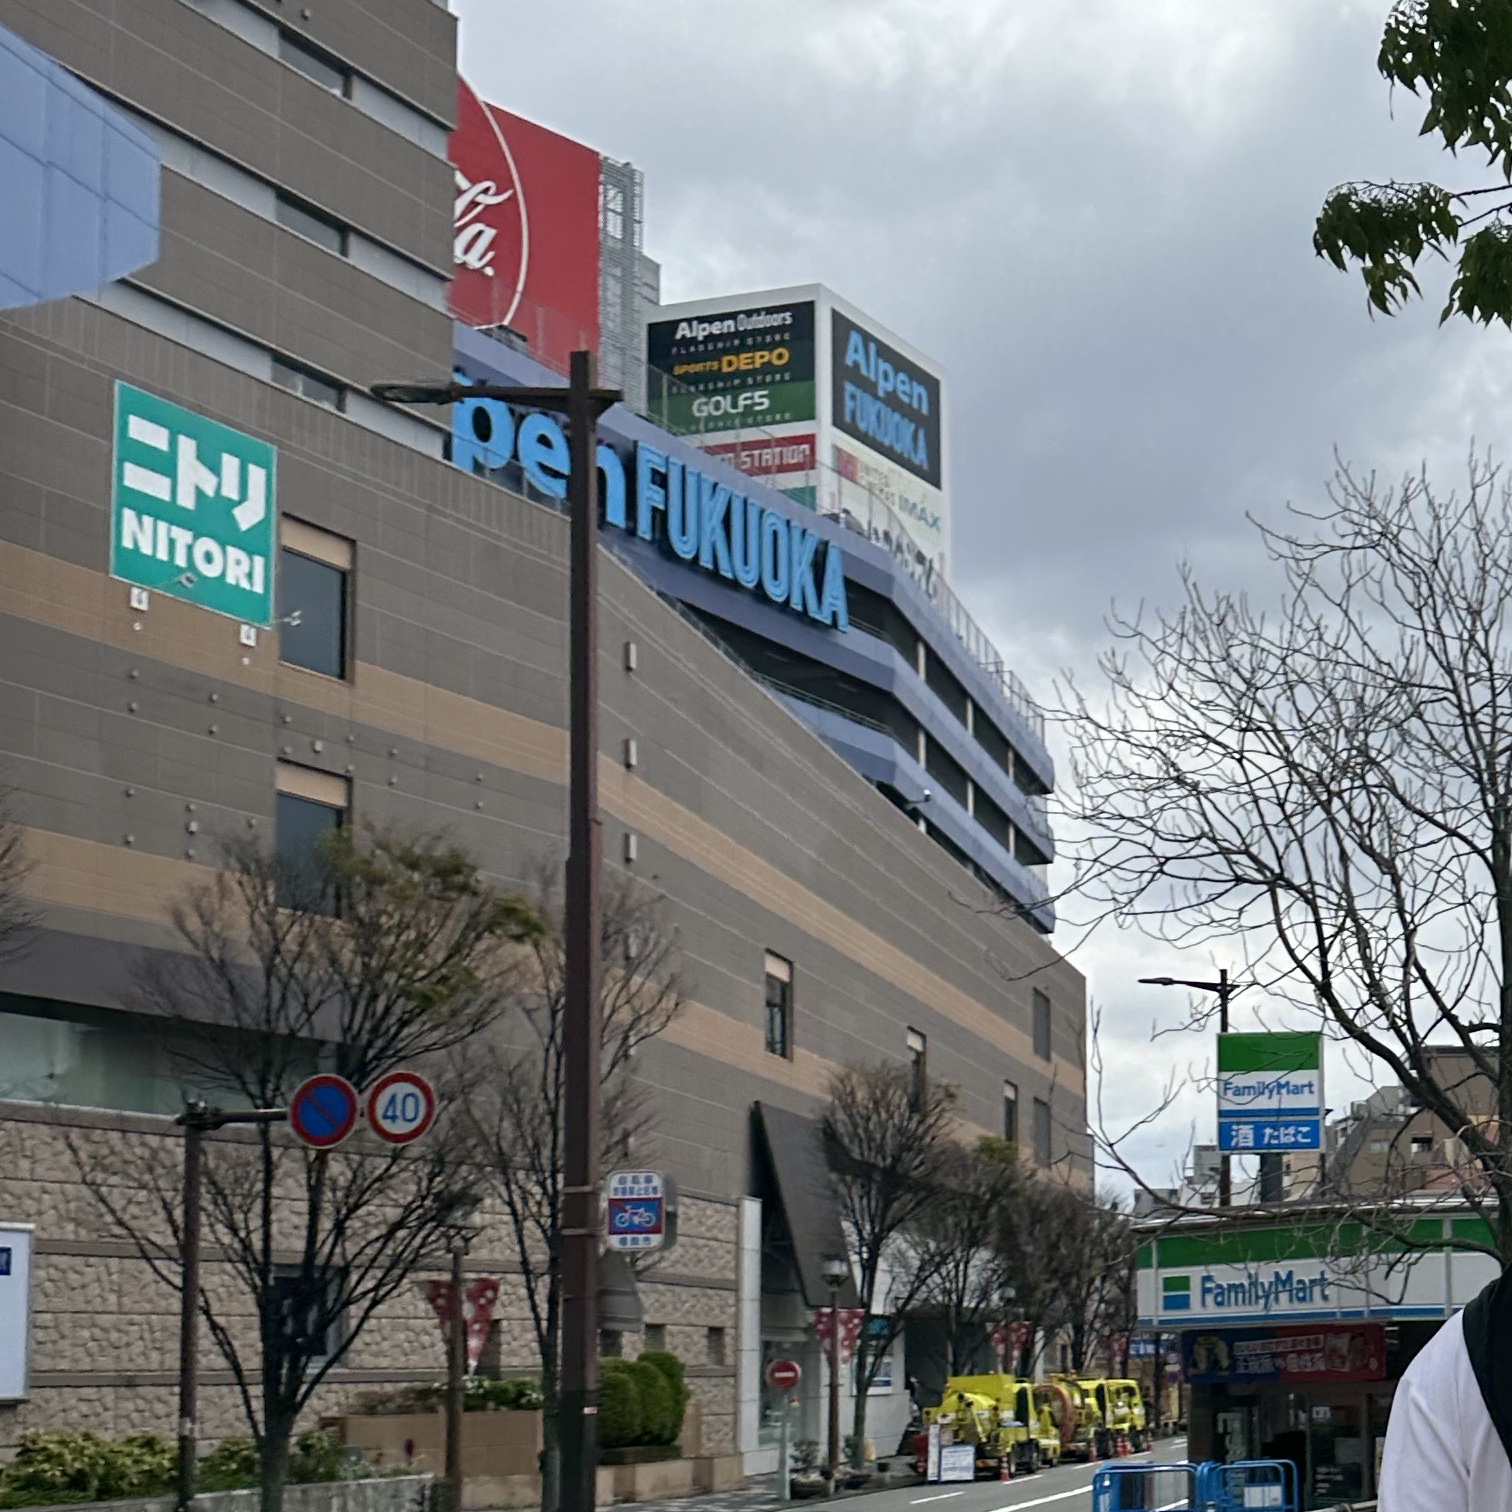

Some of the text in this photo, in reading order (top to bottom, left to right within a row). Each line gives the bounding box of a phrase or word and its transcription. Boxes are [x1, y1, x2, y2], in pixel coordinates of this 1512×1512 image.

[674, 311, 793, 341] Alpen Outdoors
[673, 347, 790, 375] SPORTS DEPO
[845, 329, 929, 417] Alpen
[692, 390, 770, 417] GOLF5
[844, 381, 928, 471] FUKUOKA
[740, 444, 810, 469] STATION
[123, 414, 266, 532] ニトリ
[122, 507, 265, 594] NITORI
[636, 440, 849, 634] FUKUOKA
[1223, 1080, 1315, 1099] FamilyMart
[382, 1092, 419, 1123] 40
[1230, 1124, 1312, 1148] 酒 たばこ
[1201, 1270, 1330, 1311] FamilyMart
